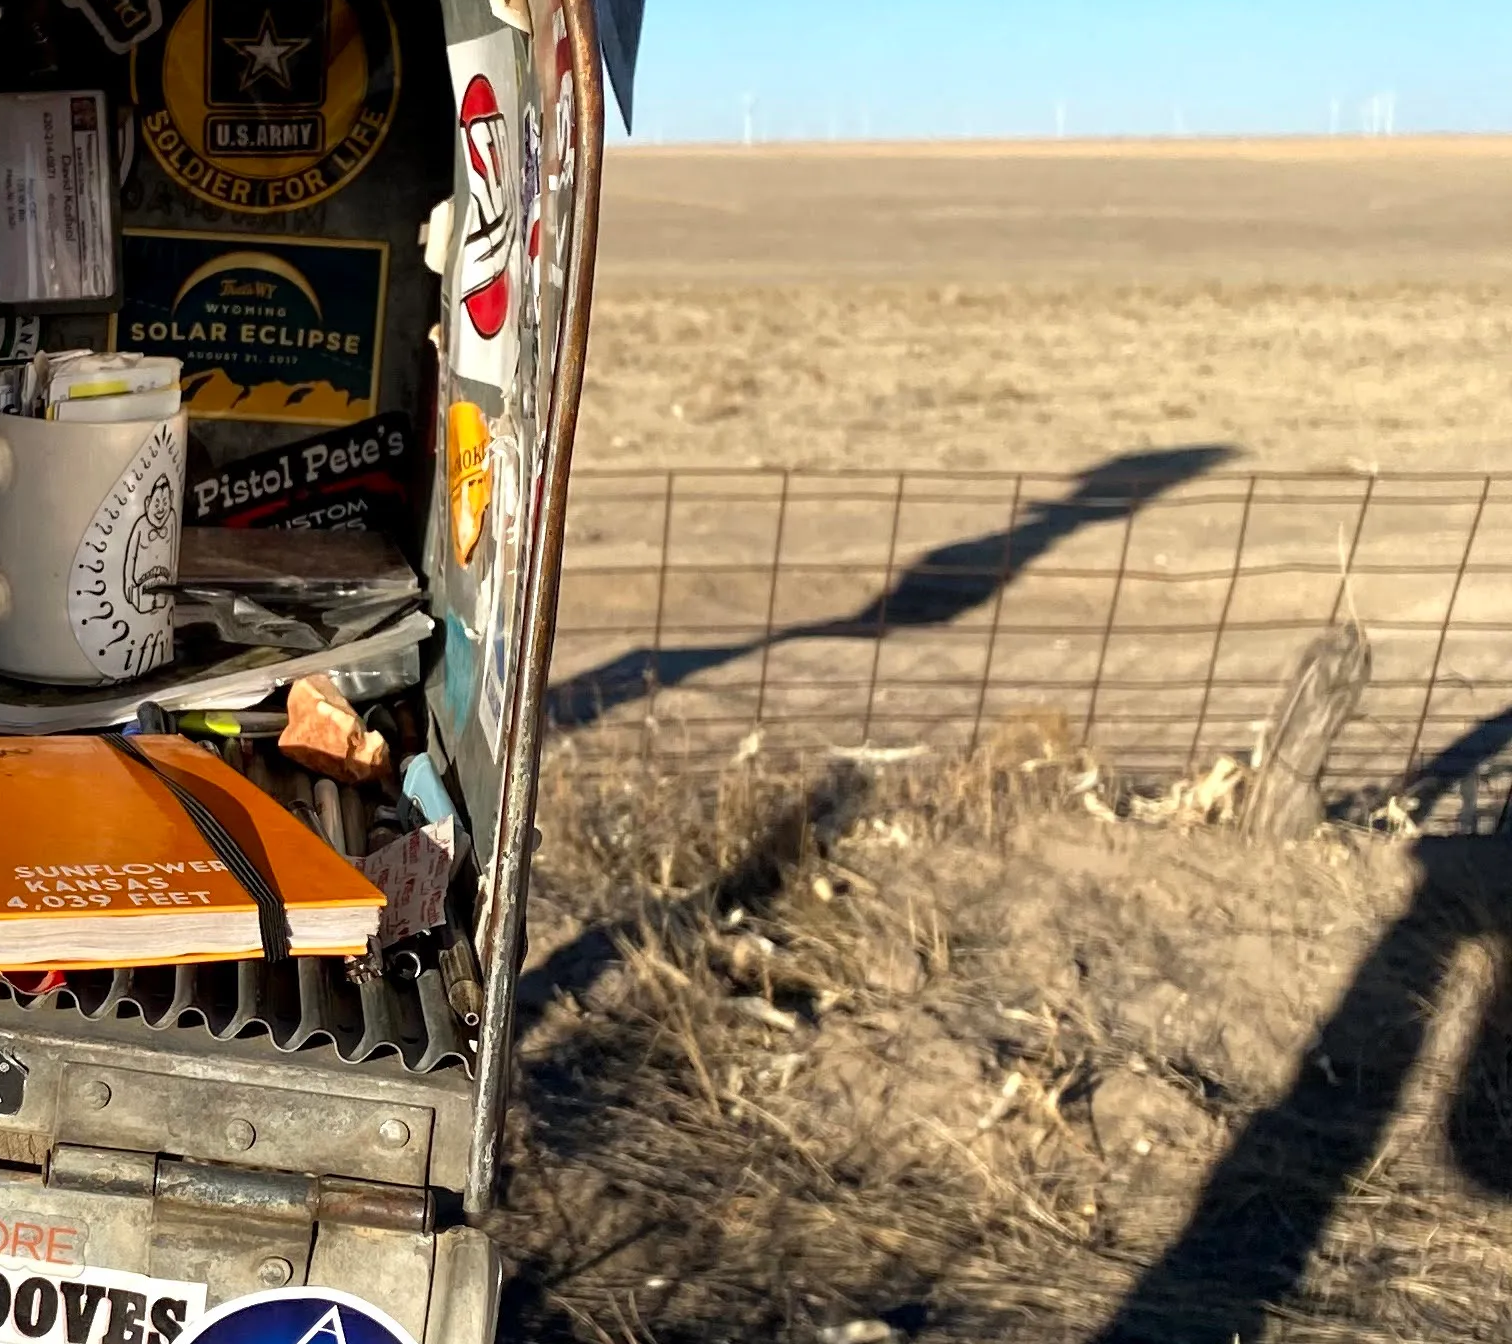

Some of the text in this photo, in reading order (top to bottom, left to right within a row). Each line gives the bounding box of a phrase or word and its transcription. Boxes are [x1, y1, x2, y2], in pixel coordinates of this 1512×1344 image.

[145, 109, 251, 205] SOLDIER
[266, 167, 328, 205] FOR
[331, 106, 385, 173] LIFE
[204, 301, 288, 319] WYOMING
[129, 321, 361, 356] SOLAR ECLIPSE
[186, 350, 239, 363] AUGUST
[193, 423, 405, 518] Pistol Pete's
[266, 496, 369, 531] USTOM
[13, 859, 230, 881] SUNFLOWER
[24, 876, 169, 893] KANSAS
[6, 890, 210, 911] 4,039 FEET
